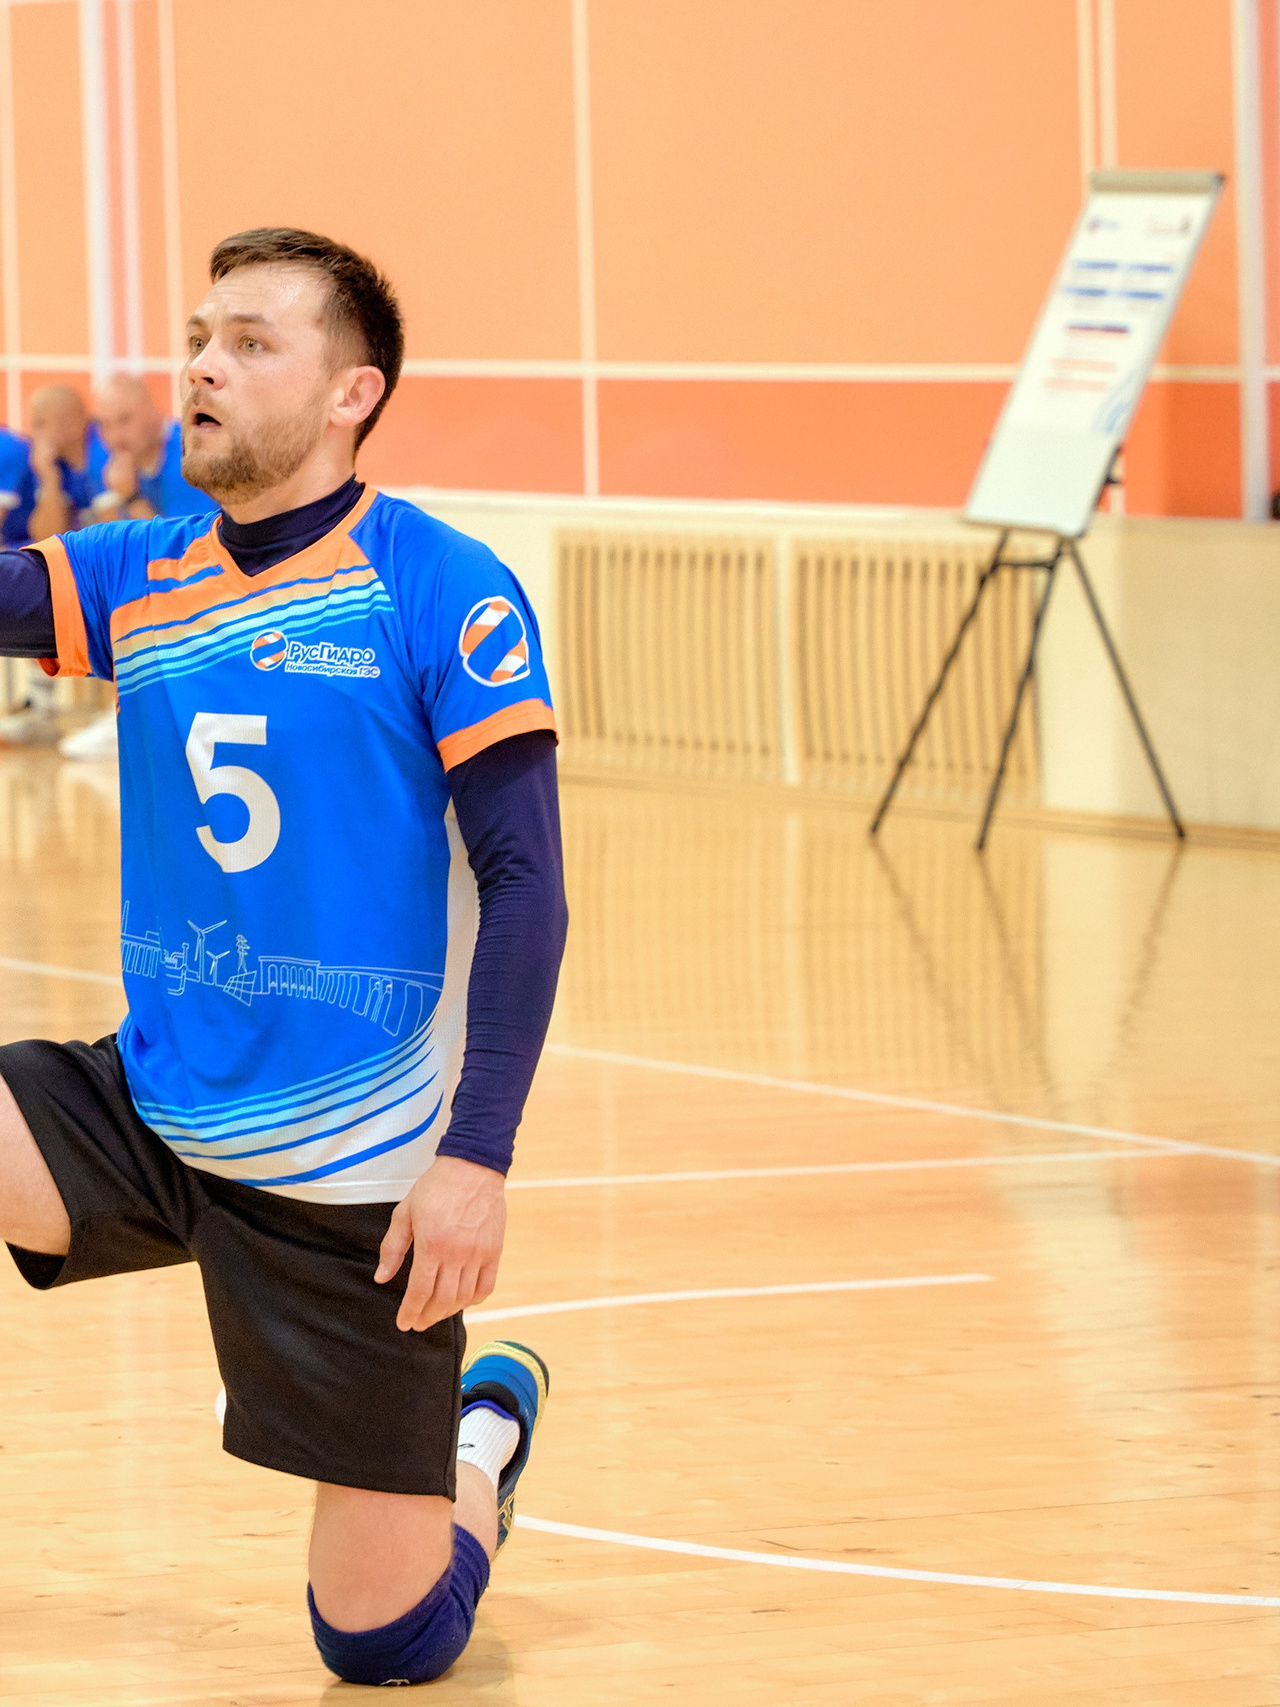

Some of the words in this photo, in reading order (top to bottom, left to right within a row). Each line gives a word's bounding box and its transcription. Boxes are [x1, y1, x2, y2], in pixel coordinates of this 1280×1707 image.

[289, 642, 375, 666] РусГидро
[359, 666, 379, 677] ГЭС
[185, 711, 281, 873] 5
